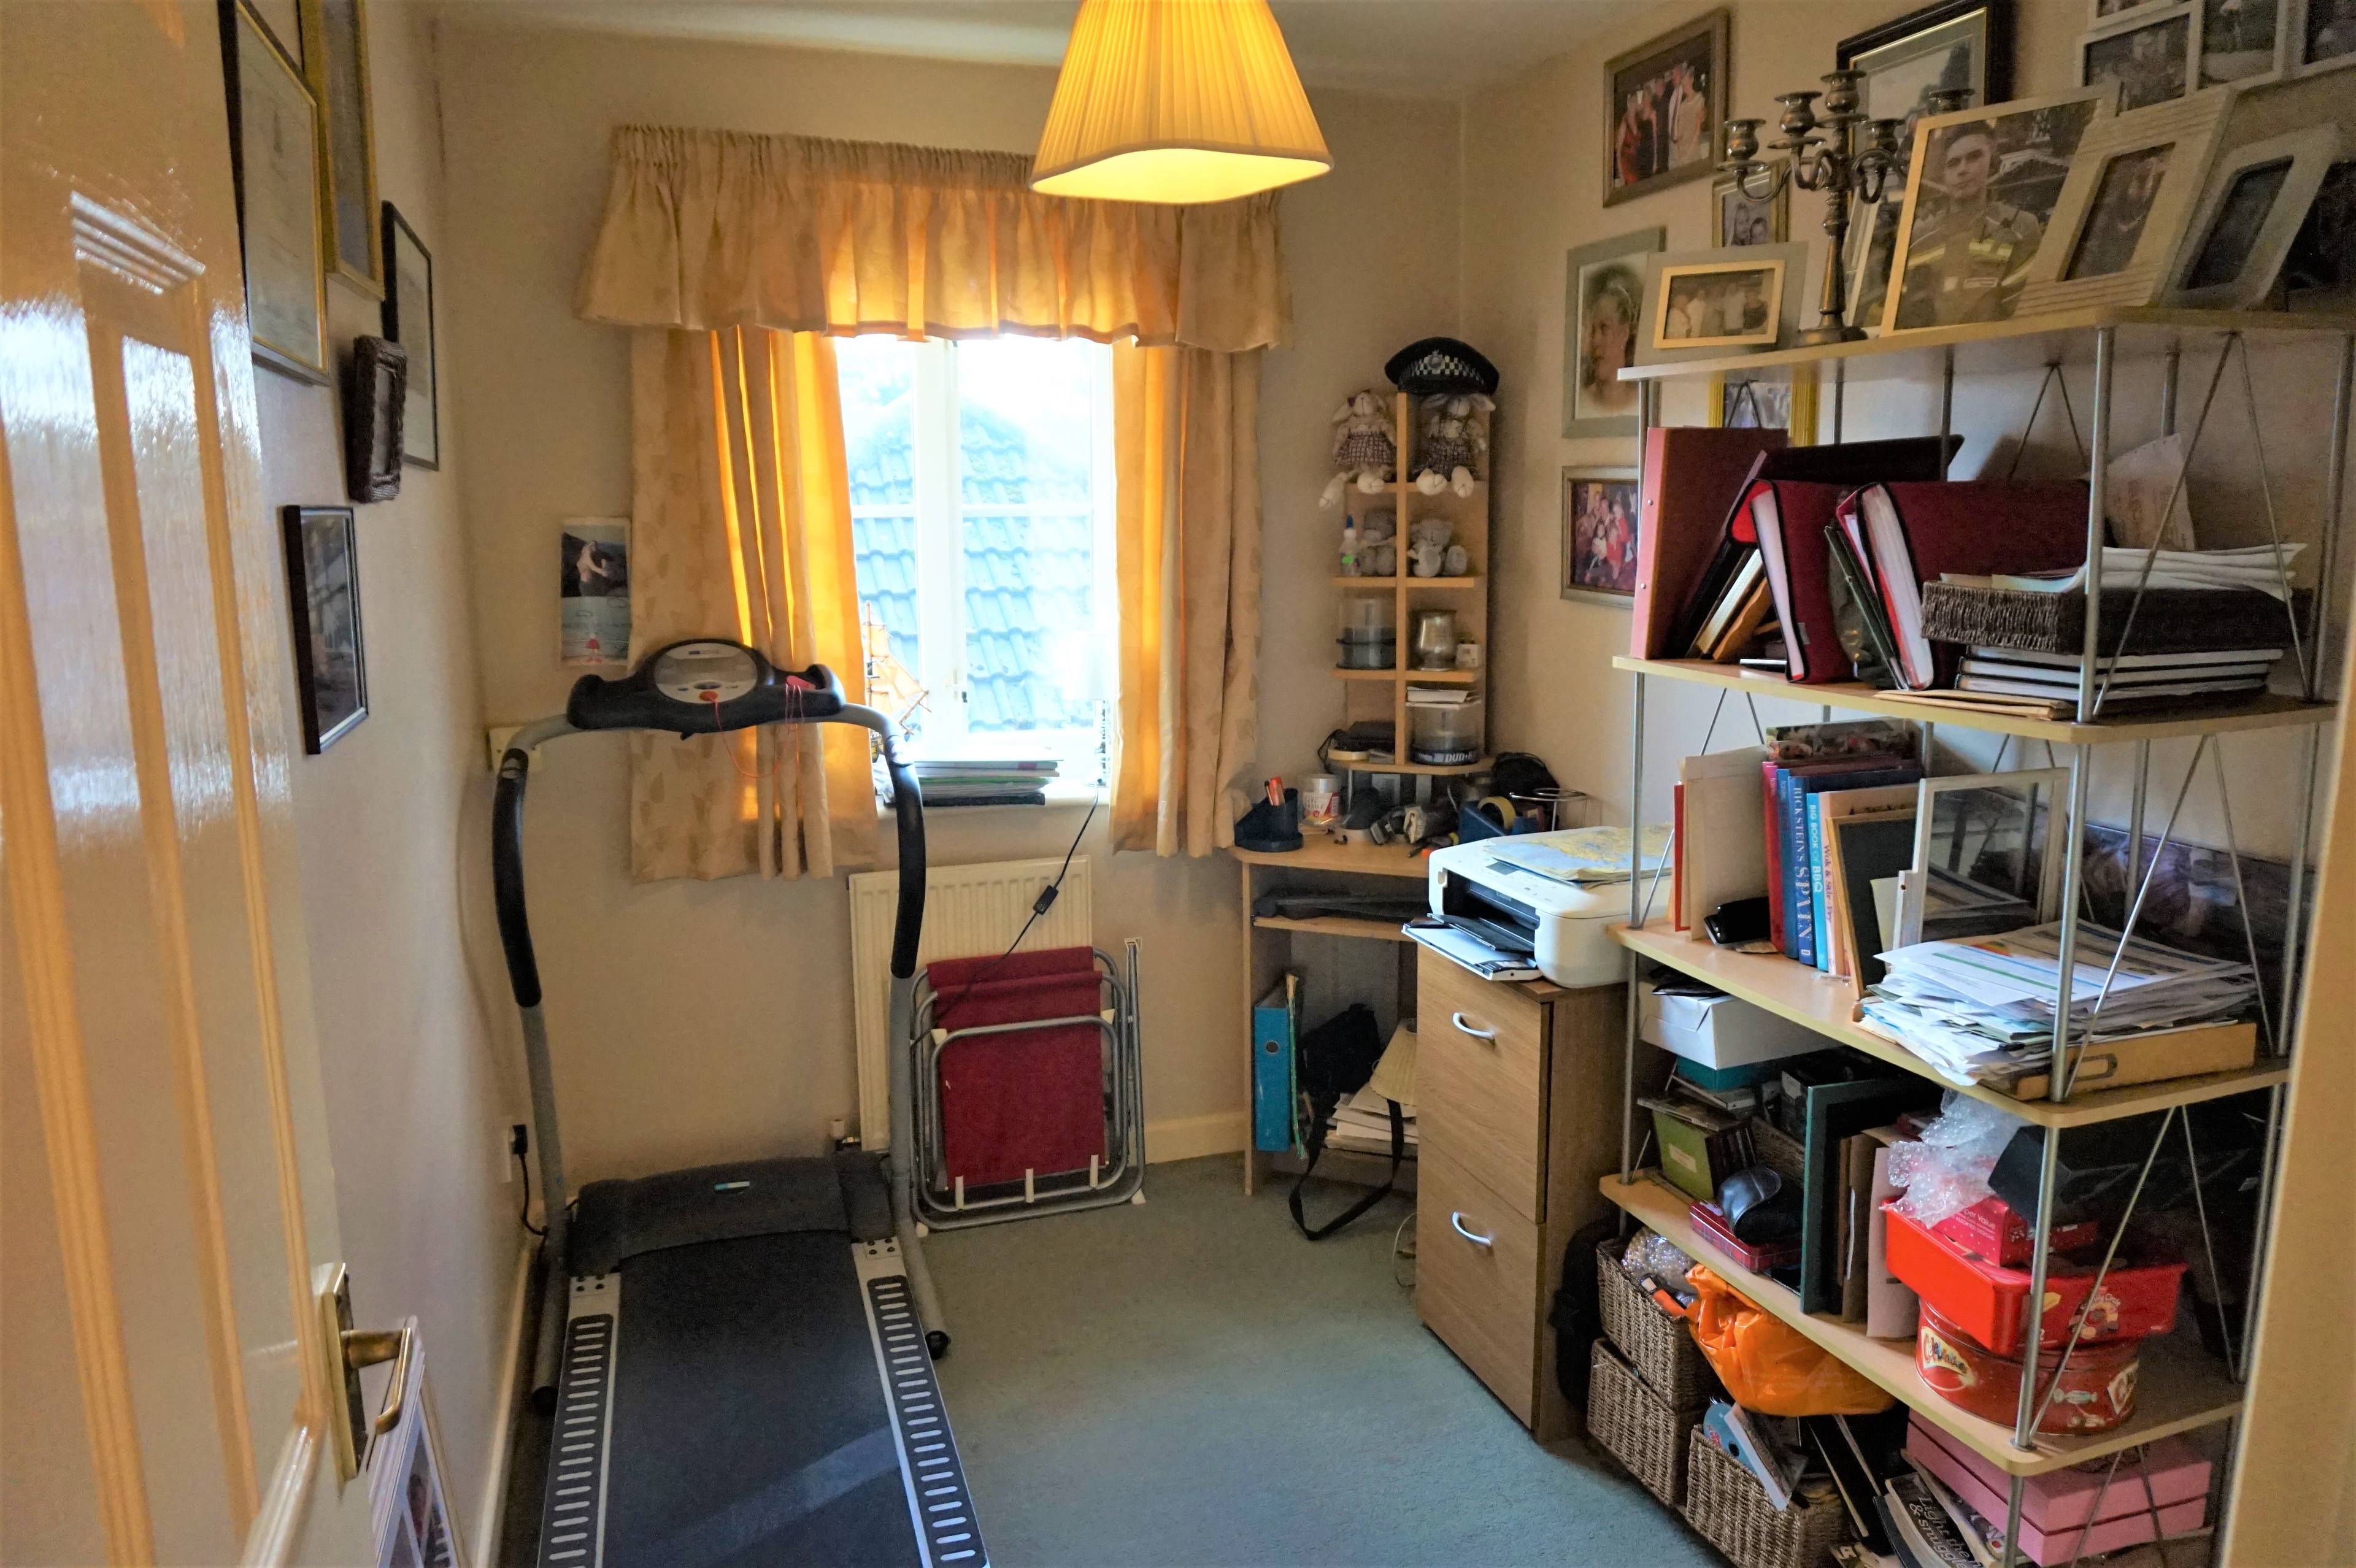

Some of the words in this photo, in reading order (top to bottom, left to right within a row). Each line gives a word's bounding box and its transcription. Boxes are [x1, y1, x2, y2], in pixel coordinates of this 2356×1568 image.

[1794, 787, 1803, 815] RICK
[1796, 817, 1805, 861] STEIN'S
[1795, 866, 1812, 938] SPAIN
[1813, 866, 1823, 893] BBQ
[1909, 1503, 1923, 1516] &
[1918, 1519, 1968, 1568] snuggle
[1918, 1496, 1949, 1535] Light
[1946, 1538, 1970, 1558] the
